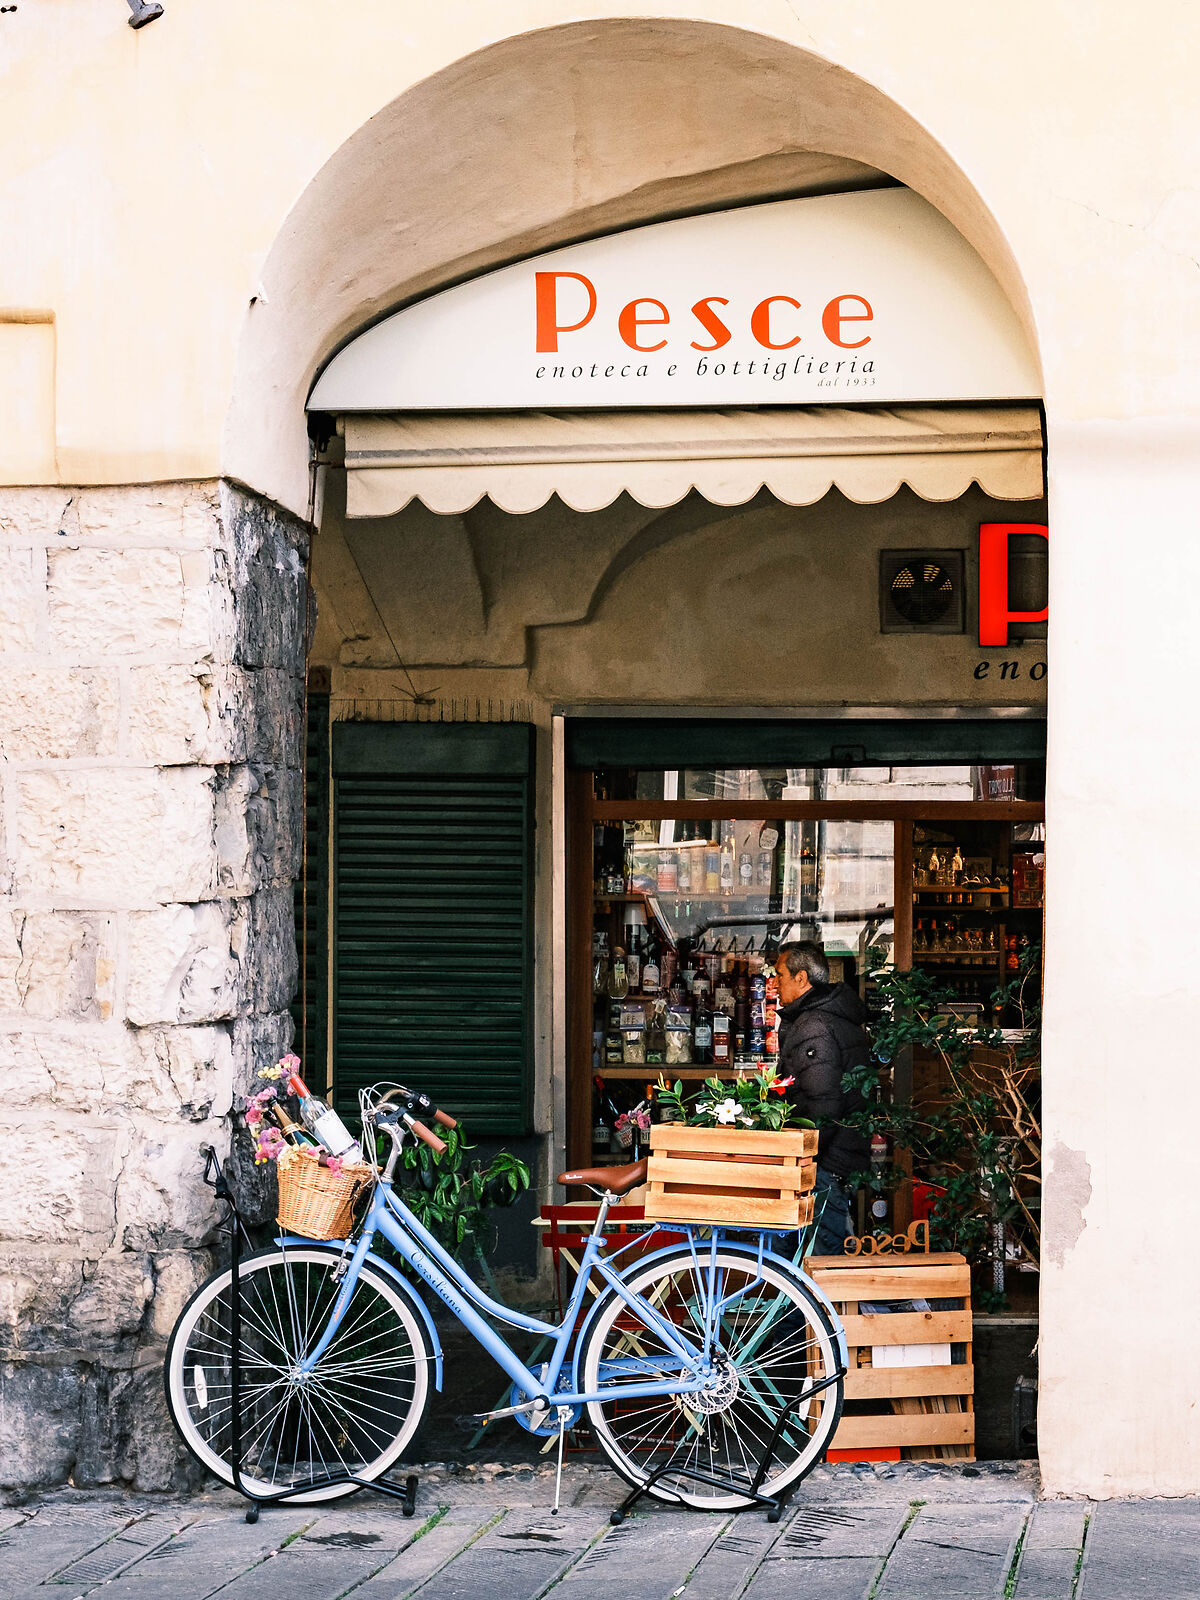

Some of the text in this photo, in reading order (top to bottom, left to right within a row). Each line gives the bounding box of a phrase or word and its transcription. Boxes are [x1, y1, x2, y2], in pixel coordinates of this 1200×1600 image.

[535, 271, 874, 353] Pesce
[535, 355, 876, 381] enoteca e bottiglieria
[817, 377, 876, 387] dal 1933
[974, 661, 1048, 681] eno
[409, 1249, 462, 1314] Versiliana
